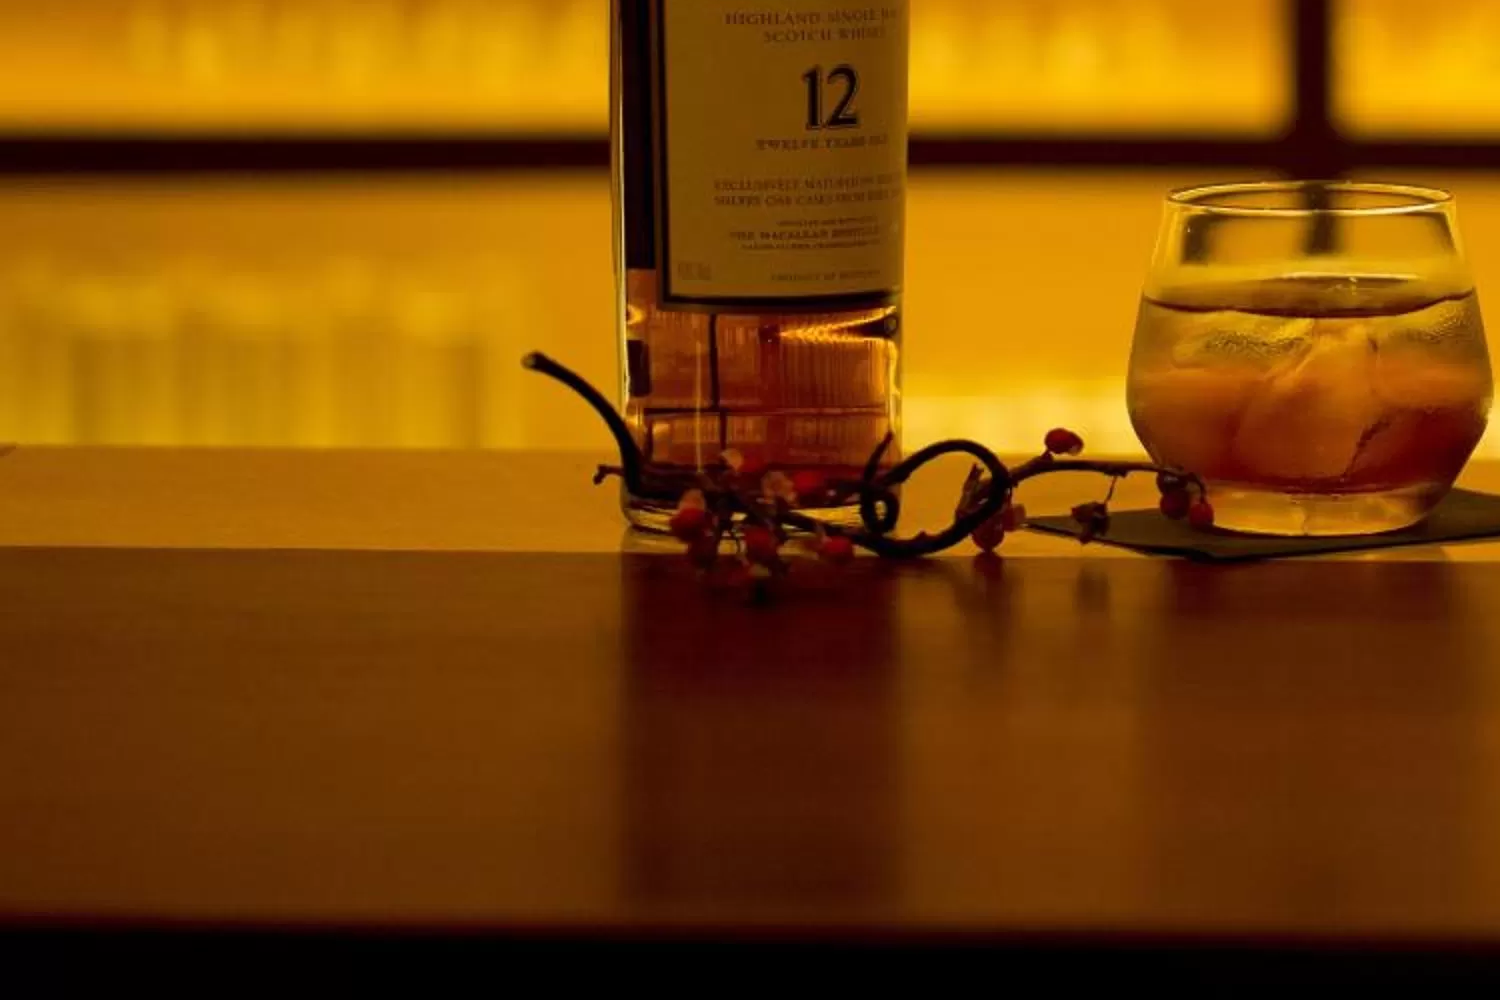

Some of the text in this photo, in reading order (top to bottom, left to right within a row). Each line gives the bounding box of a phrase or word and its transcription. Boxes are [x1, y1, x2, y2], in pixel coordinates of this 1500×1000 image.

[724, 10, 822, 26] HIGHLAND
[763, 28, 832, 44] SCOTCH
[801, 63, 858, 131] 12
